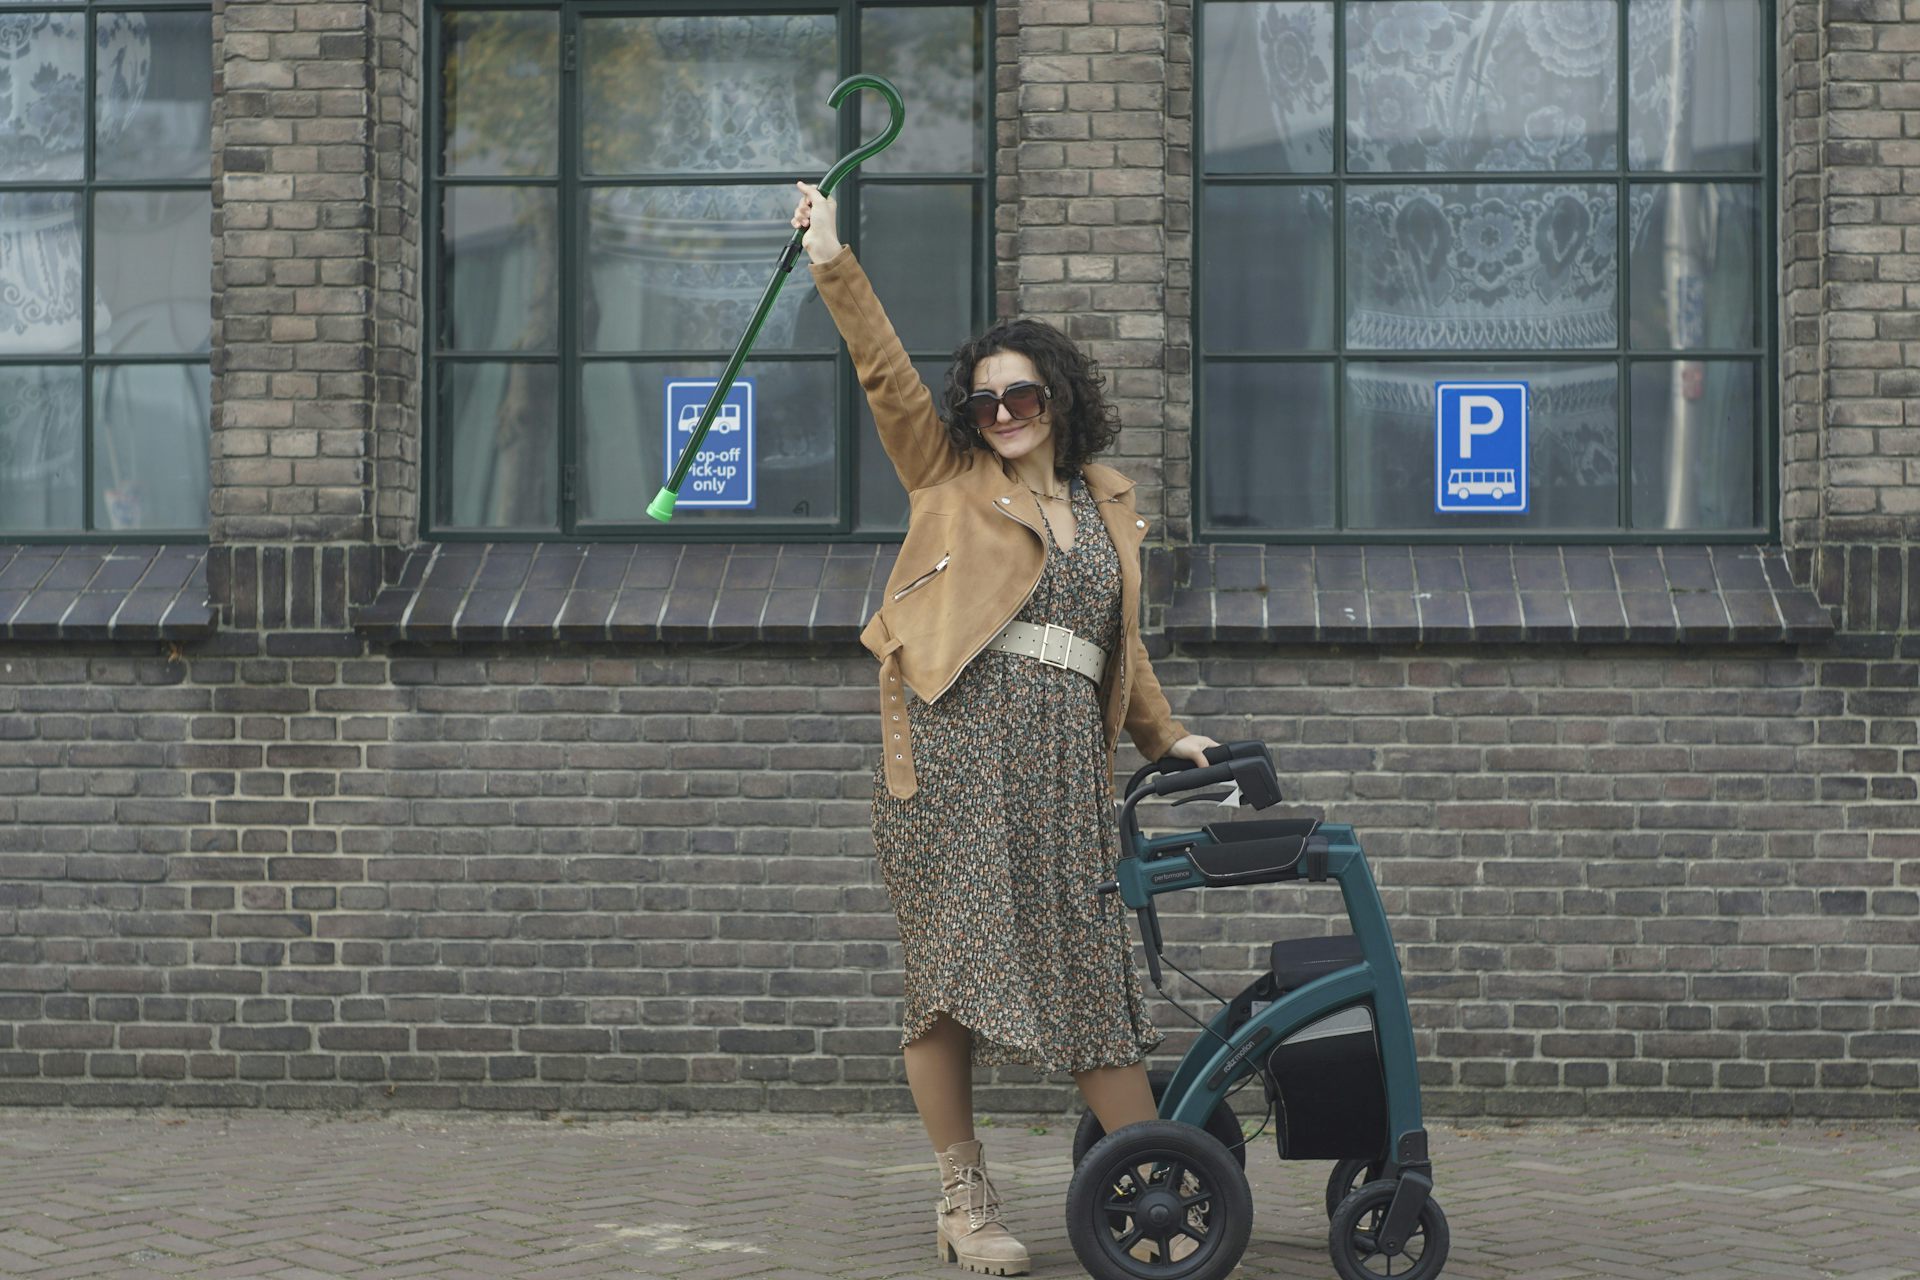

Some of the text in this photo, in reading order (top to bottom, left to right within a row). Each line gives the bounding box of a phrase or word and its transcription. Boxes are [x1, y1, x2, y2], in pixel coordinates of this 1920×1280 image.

[1460, 395, 1504, 458] P
[680, 448, 741, 464] op-off
[687, 463, 736, 480] ick-up
[693, 477, 726, 494] only
